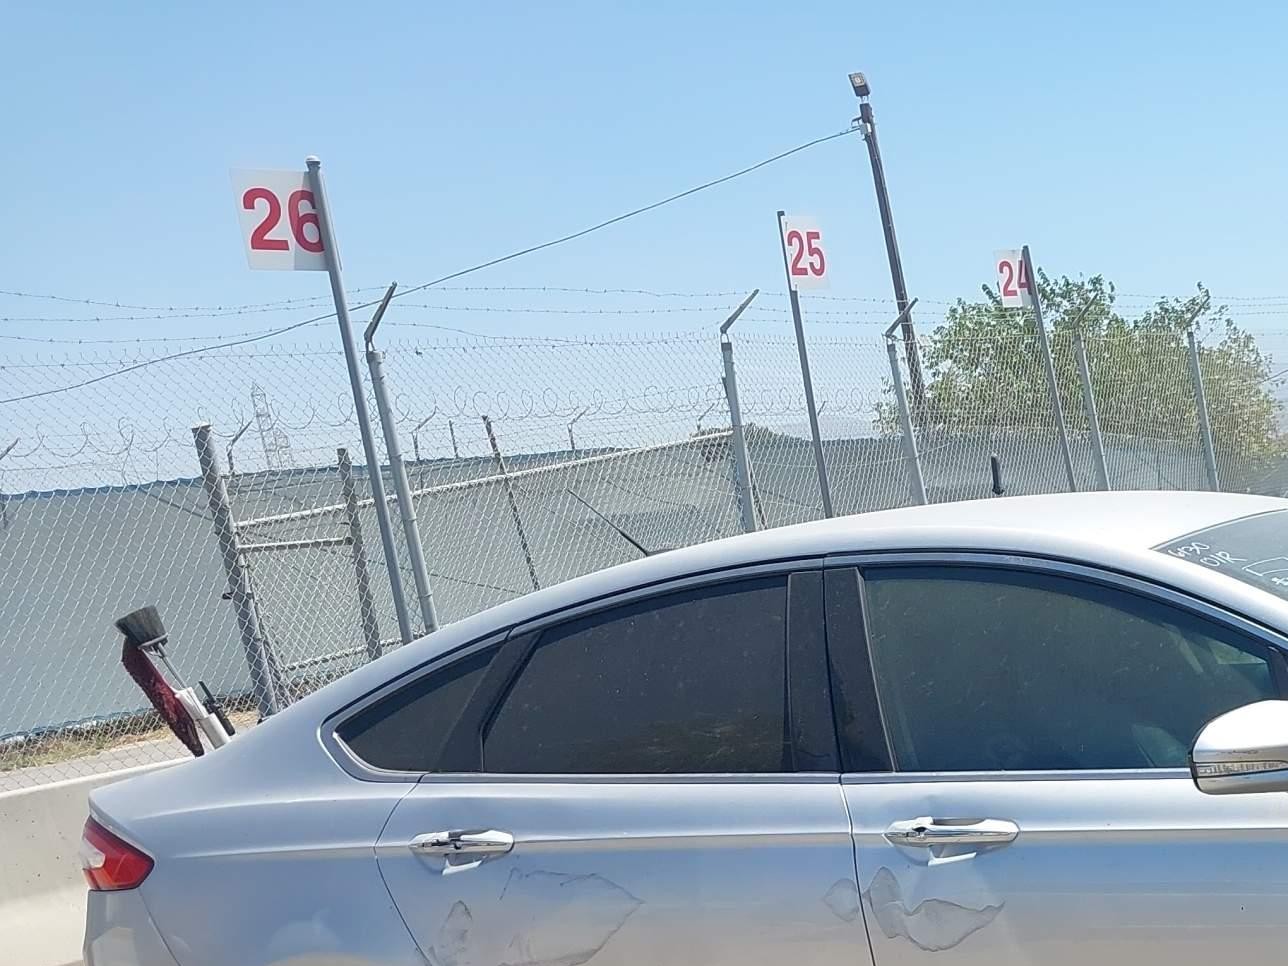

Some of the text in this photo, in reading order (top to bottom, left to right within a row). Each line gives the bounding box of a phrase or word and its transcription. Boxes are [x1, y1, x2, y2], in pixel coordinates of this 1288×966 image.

[242, 187, 325, 253] 26
[787, 230, 825, 276] 25
[998, 260, 1033, 297] 24
